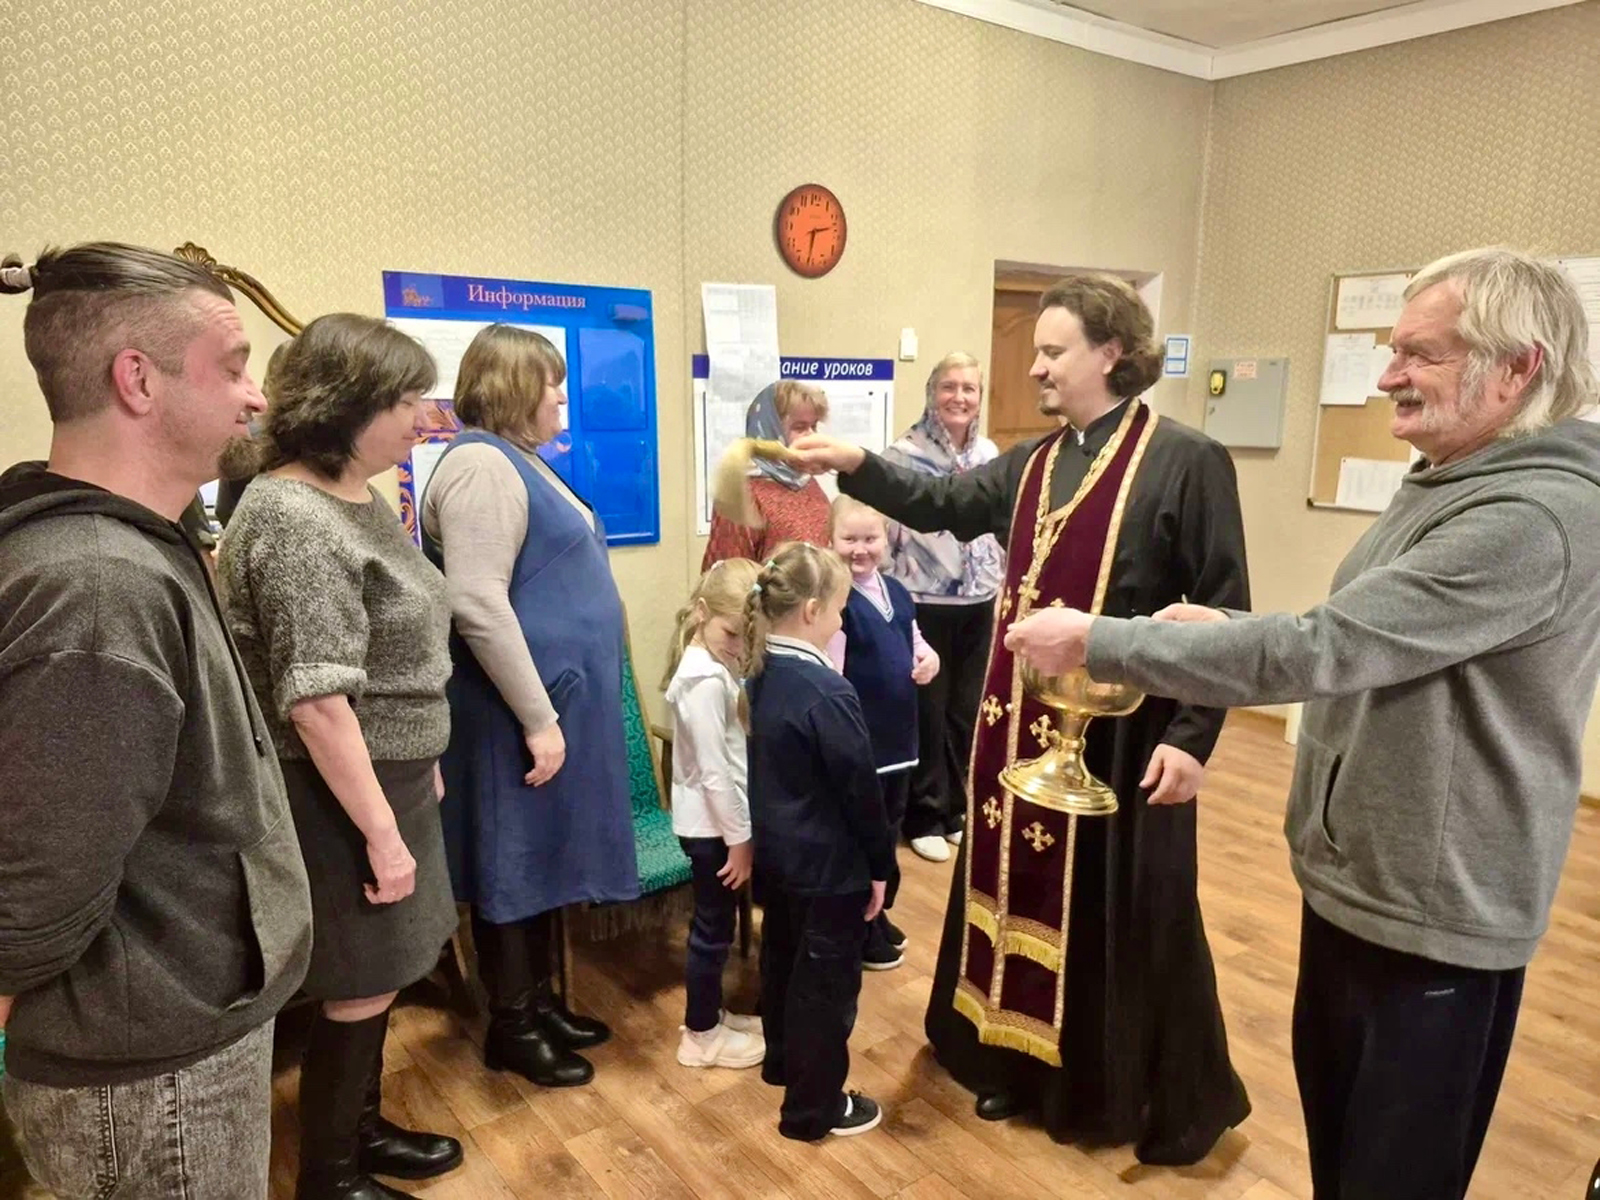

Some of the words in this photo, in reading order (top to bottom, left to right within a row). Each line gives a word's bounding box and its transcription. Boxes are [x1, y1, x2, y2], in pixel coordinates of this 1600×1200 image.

[467, 283, 586, 311] Информация
[780, 361, 819, 375] ание
[823, 362, 873, 379] уроков
